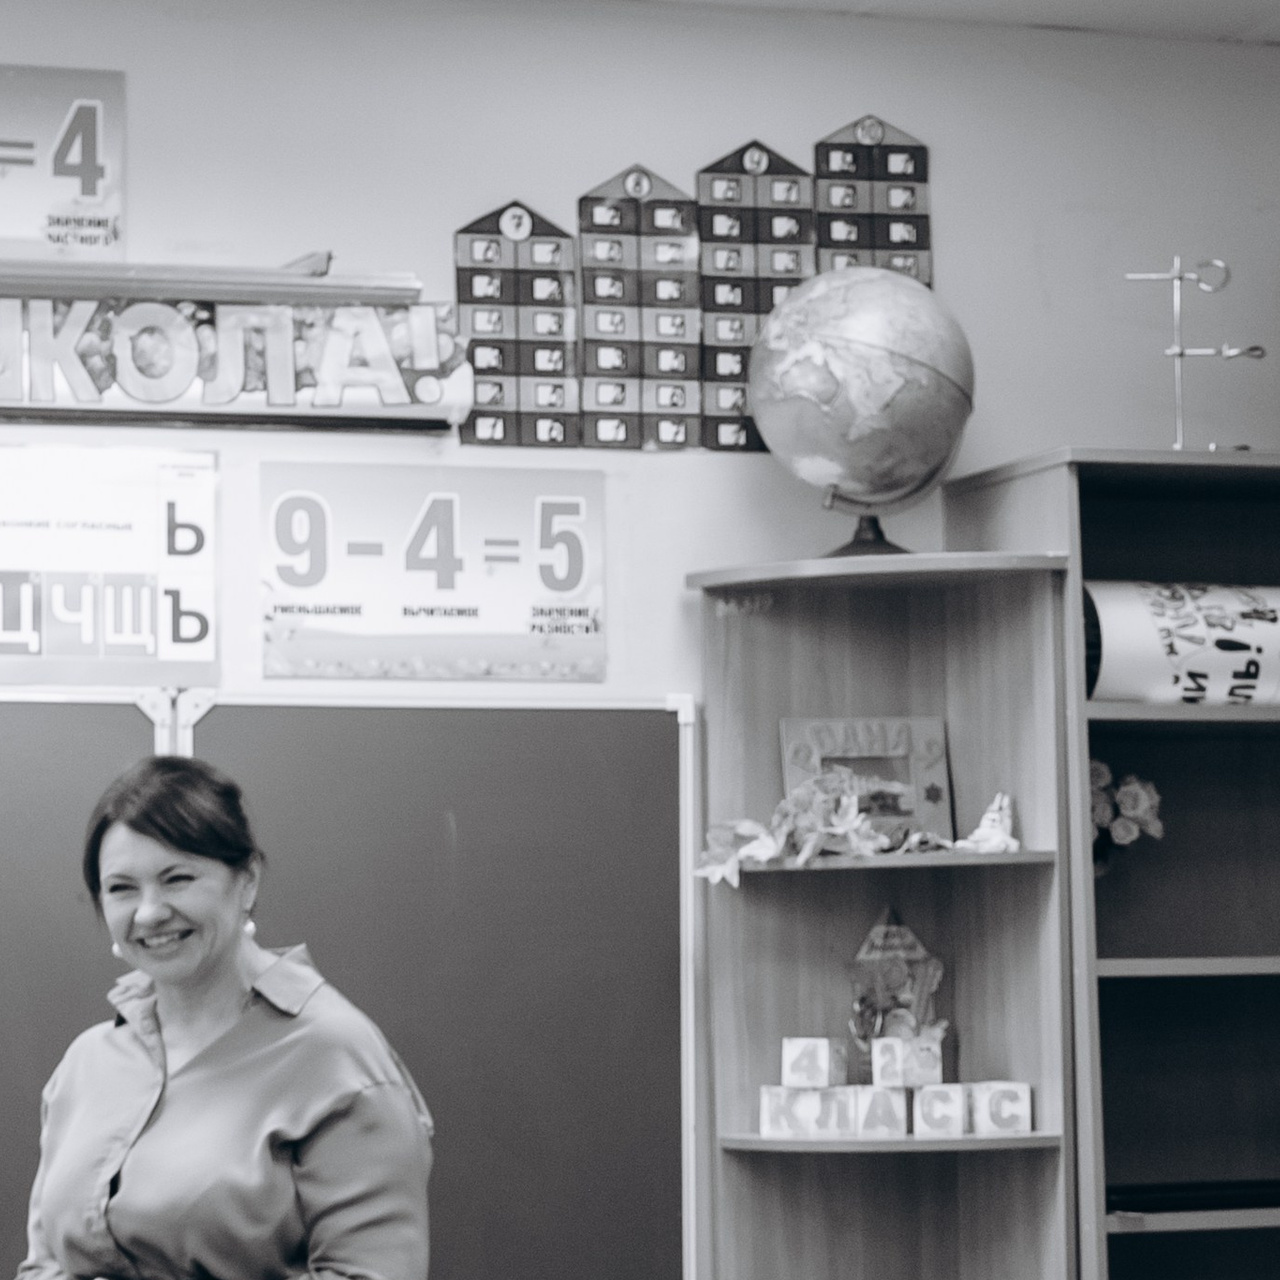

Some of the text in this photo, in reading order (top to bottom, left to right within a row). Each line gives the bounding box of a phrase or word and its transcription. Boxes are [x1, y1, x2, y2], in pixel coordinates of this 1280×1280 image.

[53, 106, 105, 196] 4
[274, 497, 328, 587] 9
[405, 498, 462, 590] 4
[537, 501, 583, 592] 5
[52, 583, 94, 644] Ч
